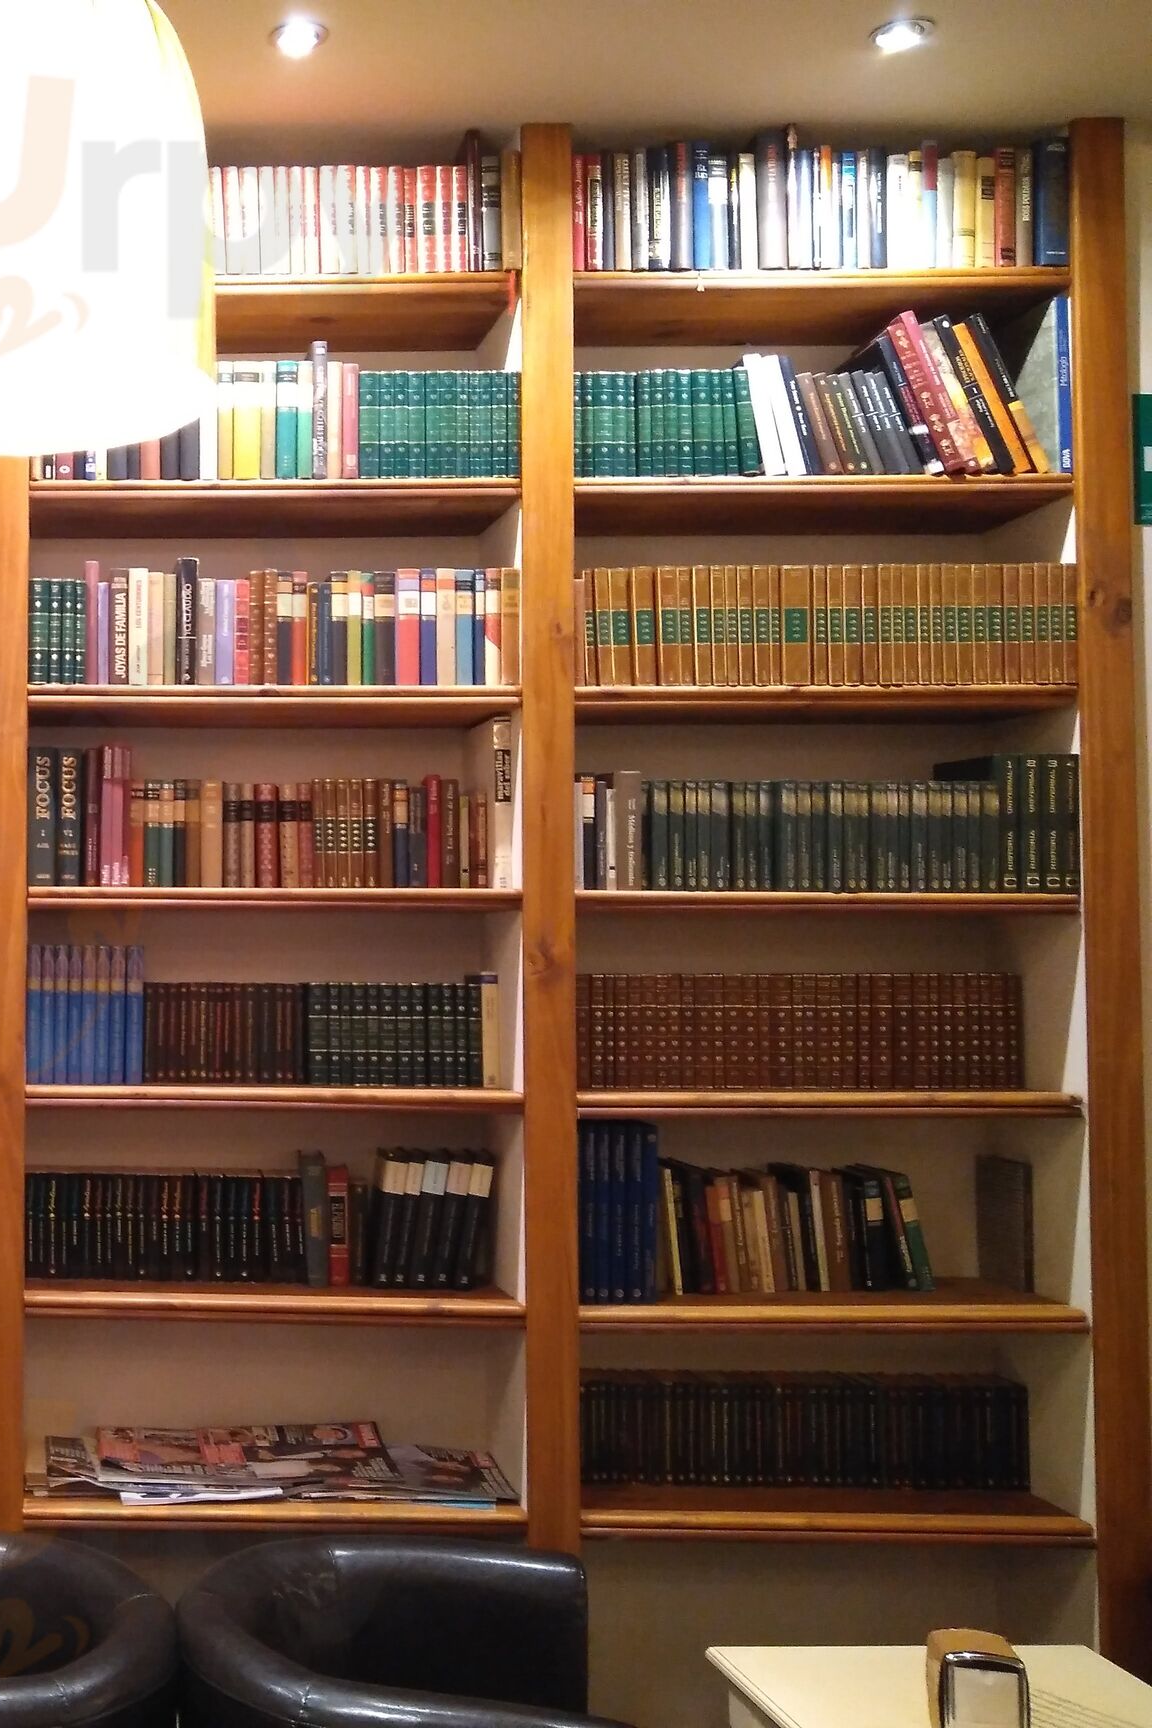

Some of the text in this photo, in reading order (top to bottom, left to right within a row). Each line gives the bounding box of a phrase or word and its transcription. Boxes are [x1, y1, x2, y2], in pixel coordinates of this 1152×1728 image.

[182, 583, 193, 622] CLAUDIO
[114, 592, 127, 679] JOYAS DE FAMILIA
[35, 756, 51, 821] FOCUS
[60, 756, 77, 821] FOCUS
[495, 750, 504, 800] maravillas
[1049, 830, 1057, 870] HISTORIA
